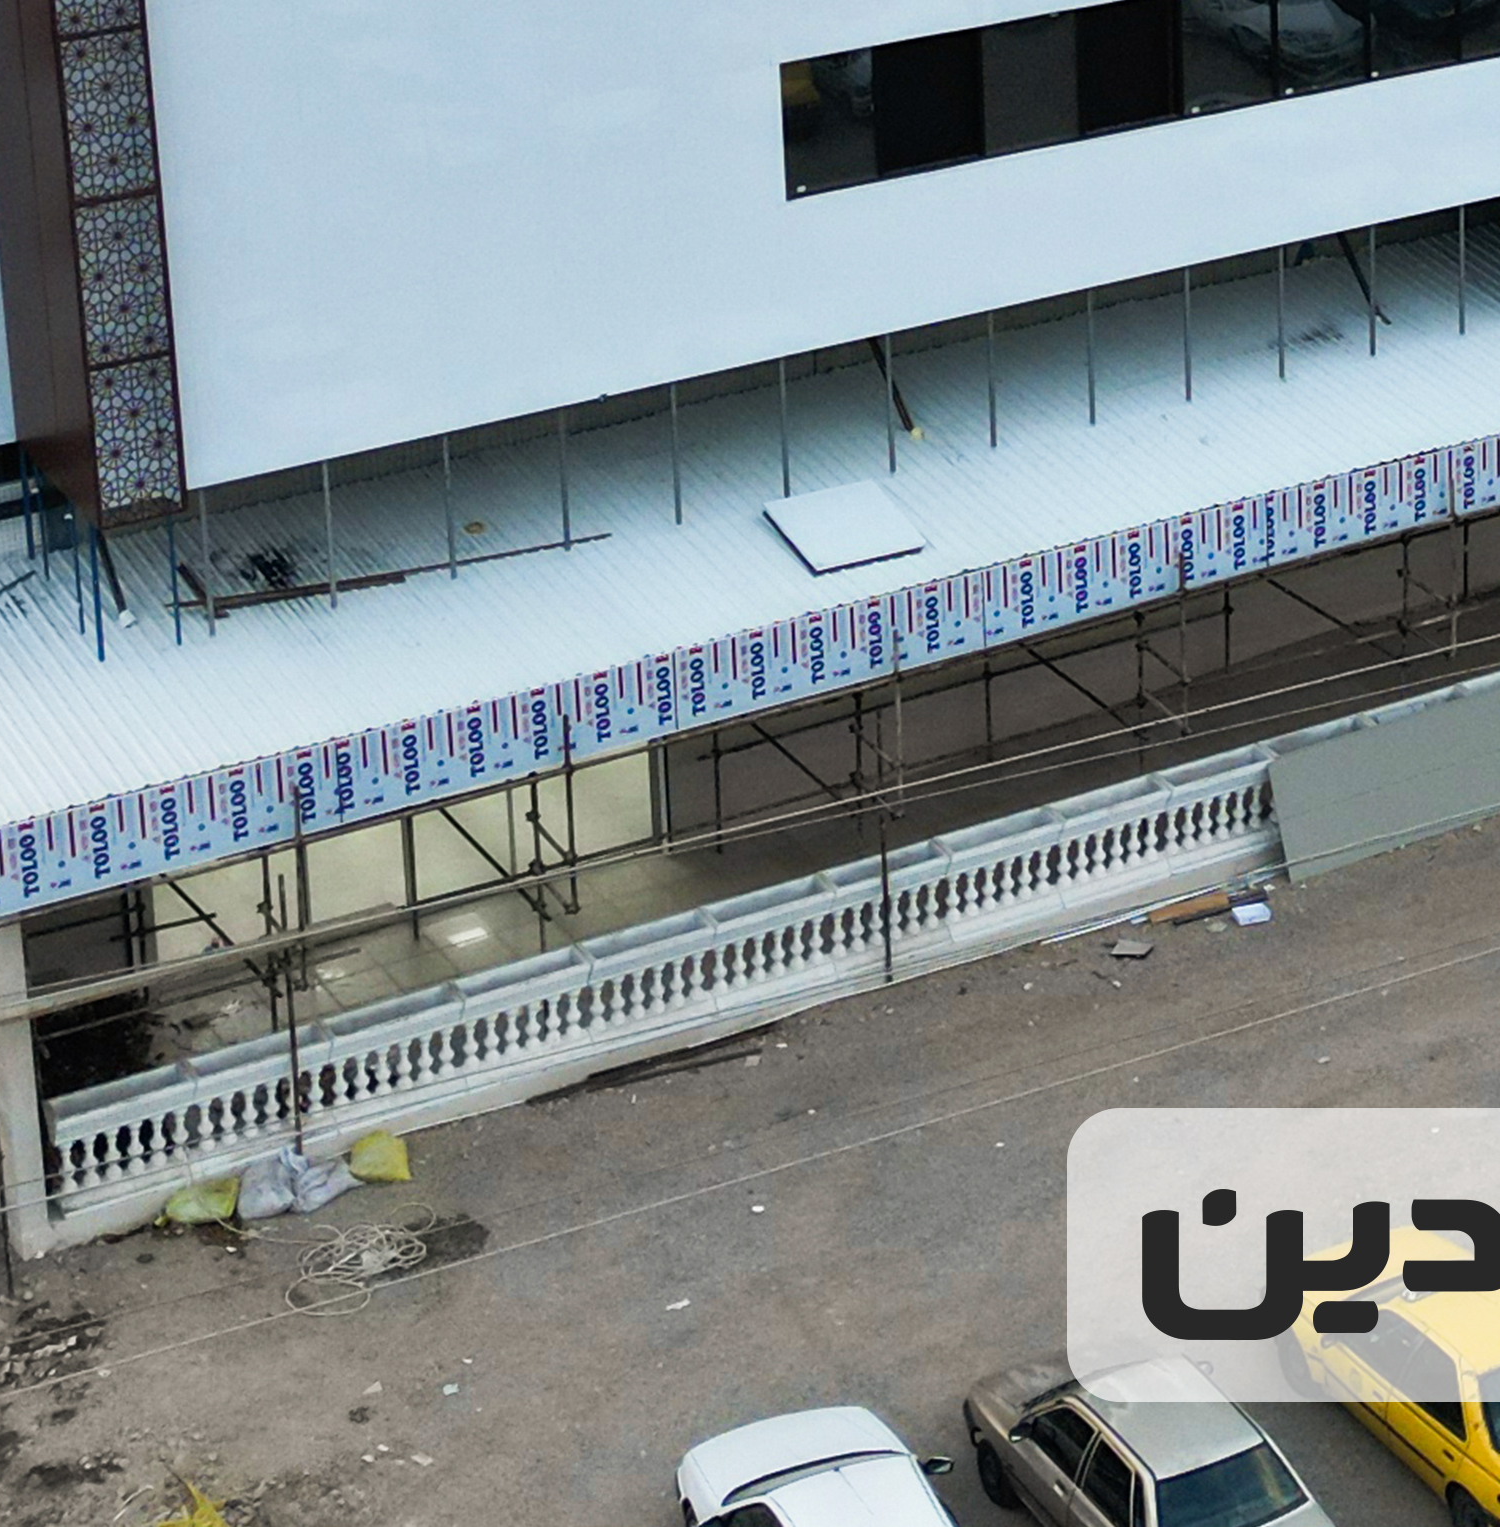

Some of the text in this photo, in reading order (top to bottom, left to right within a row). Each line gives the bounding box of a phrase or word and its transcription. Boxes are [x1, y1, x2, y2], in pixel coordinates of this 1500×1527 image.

[467, 717, 485, 778] TOLOO
[531, 699, 549, 761] TOLOO
[402, 734, 421, 796] TOLOO
[160, 798, 181, 861] TOLOO
[229, 780, 249, 842] TOLOO
[18, 834, 40, 899] TOLOO
[89, 816, 111, 880] TOLOO
